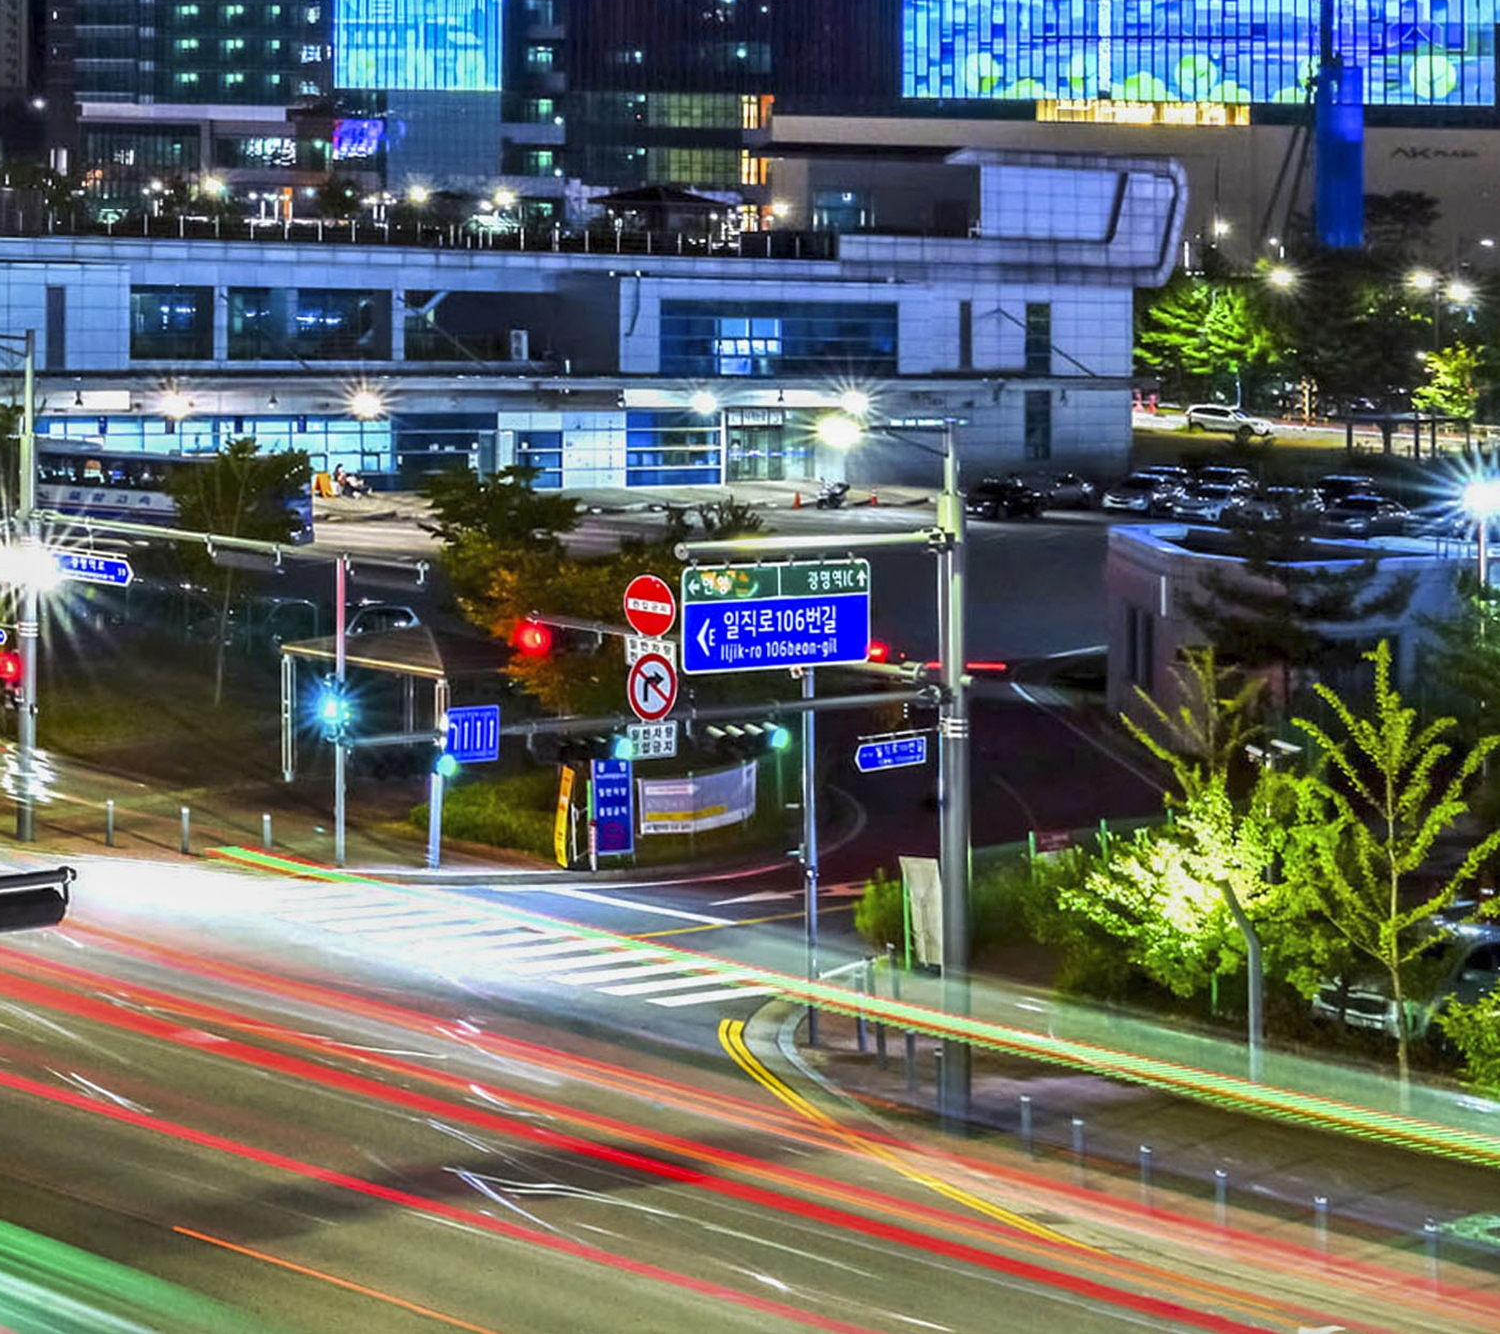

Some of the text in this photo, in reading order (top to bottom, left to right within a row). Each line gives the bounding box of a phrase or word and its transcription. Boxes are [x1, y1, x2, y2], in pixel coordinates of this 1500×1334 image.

[807, 569, 854, 591] 광명역IC
[723, 604, 837, 641] 일직로106번길
[720, 637, 838, 664] Iljik-ro 106beon-gil
